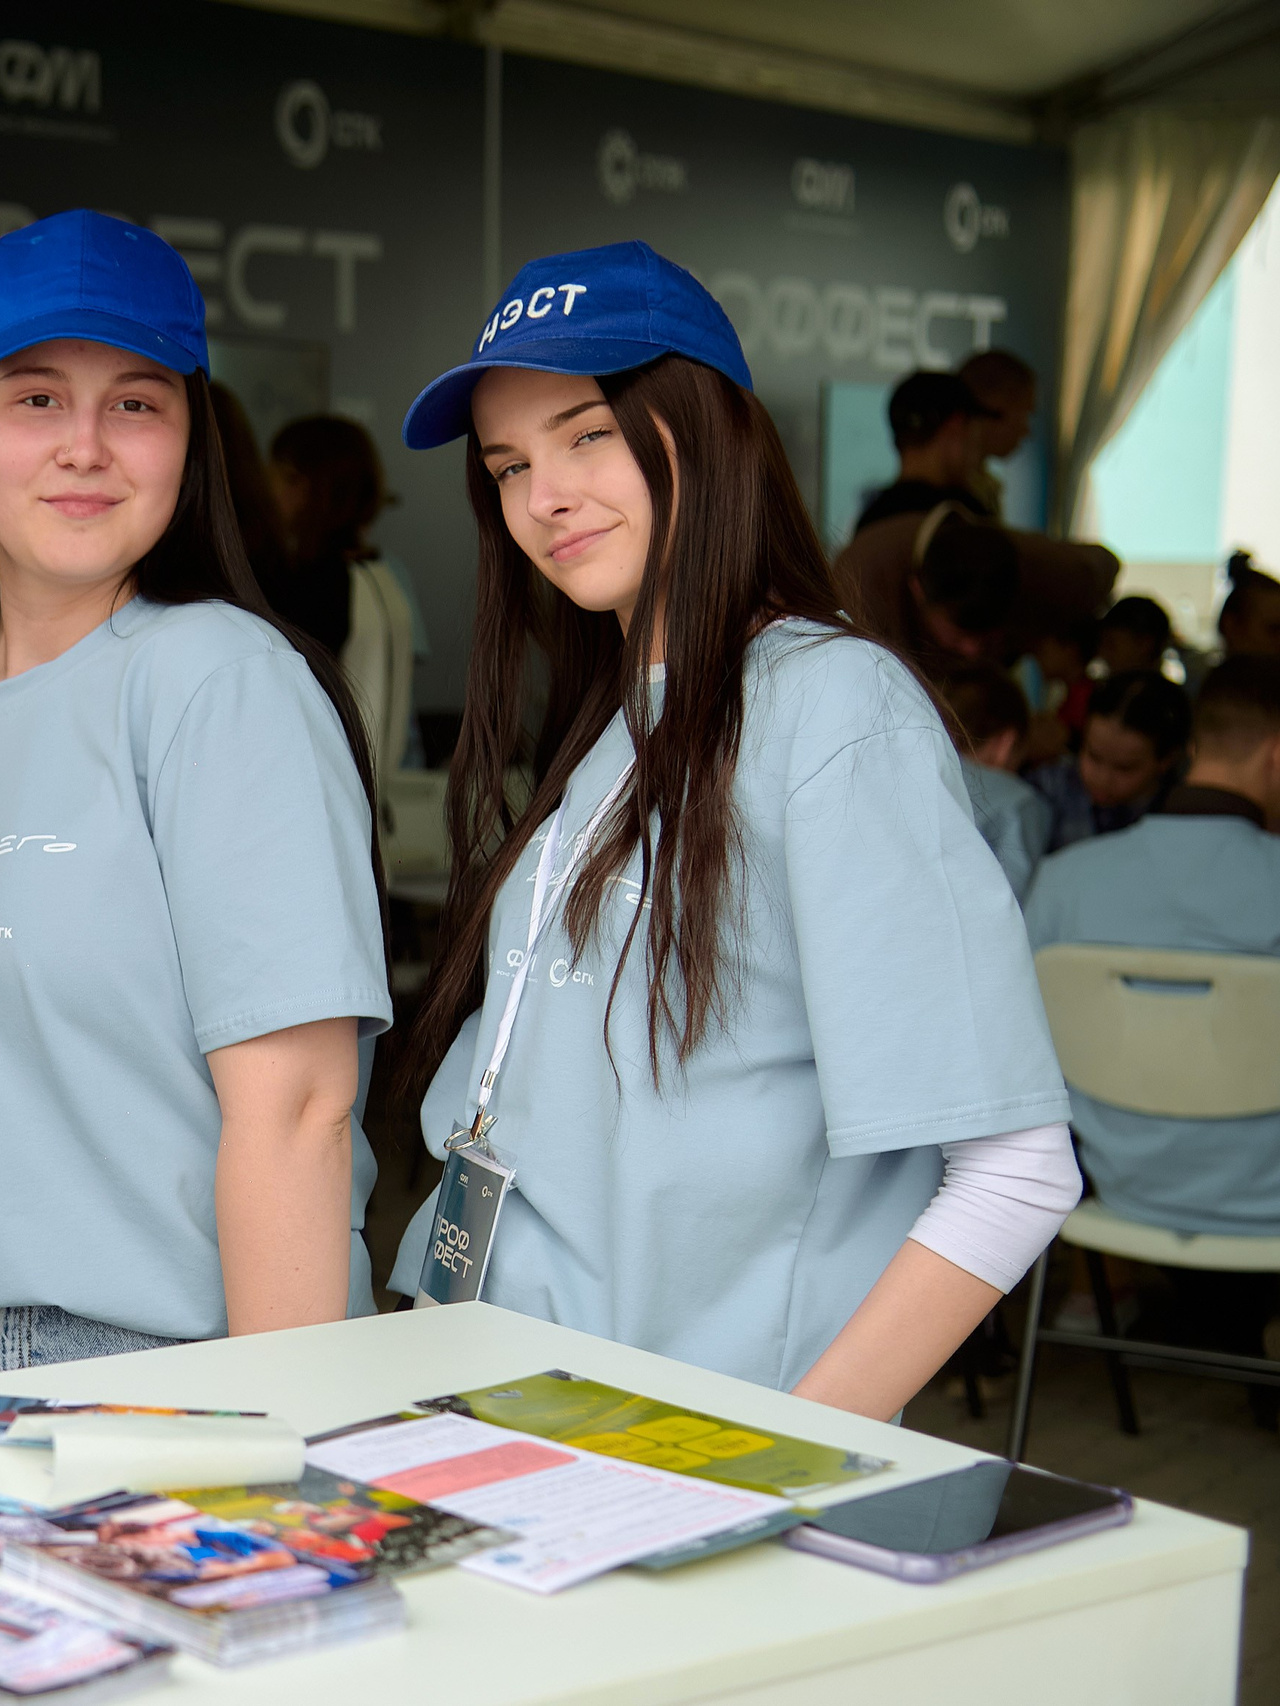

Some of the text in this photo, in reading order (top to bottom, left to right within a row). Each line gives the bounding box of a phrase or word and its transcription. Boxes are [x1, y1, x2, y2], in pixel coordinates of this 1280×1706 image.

[478, 284, 587, 353] НЭСТ
[572, 971, 594, 986] СГК
[436, 1213, 470, 1251] ПРОФ
[434, 1240, 473, 1278] ФЕСТ
